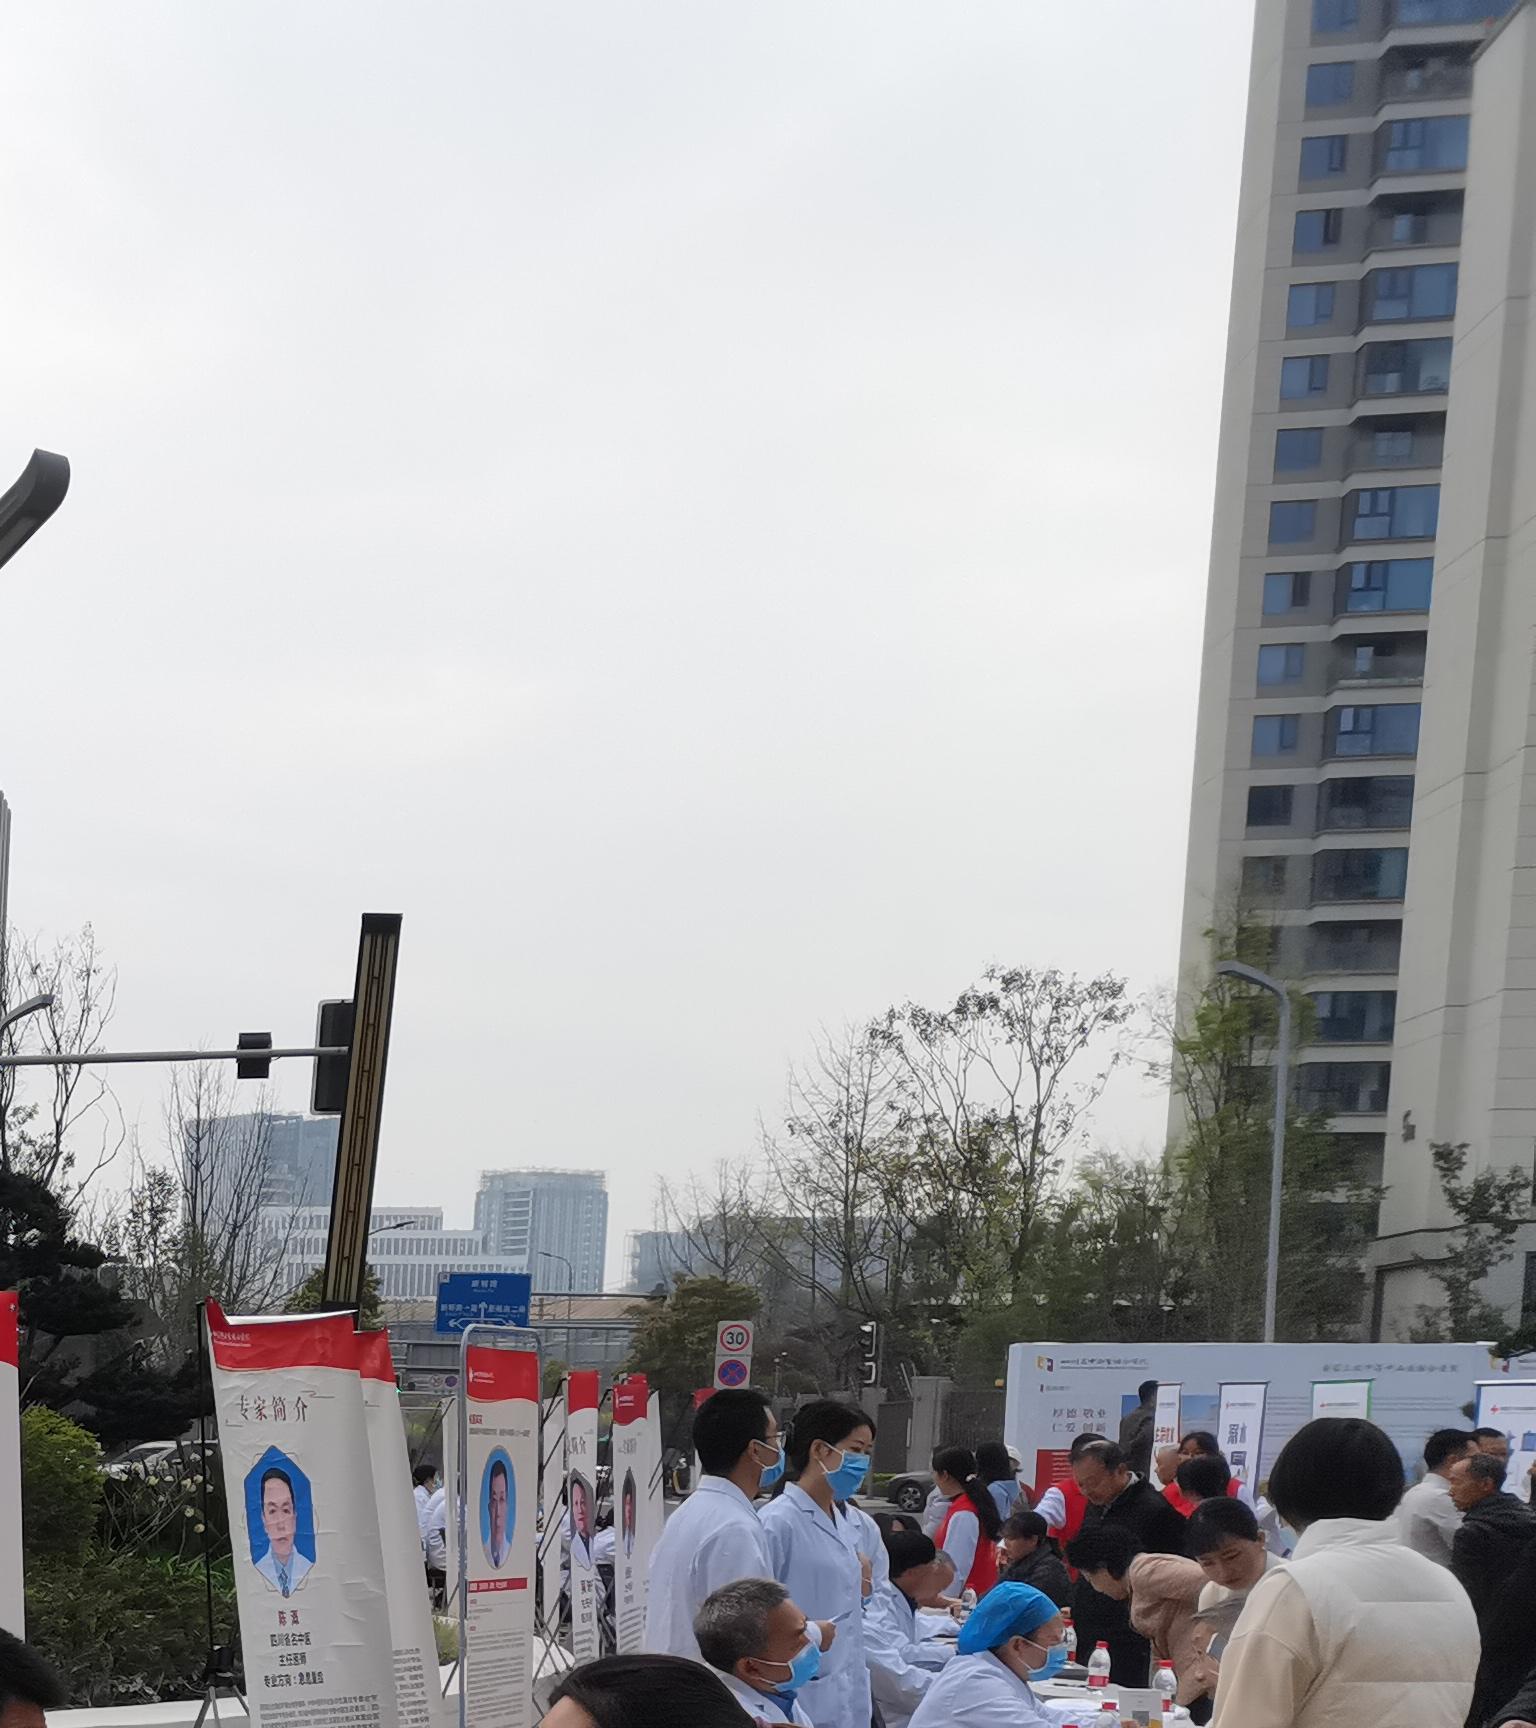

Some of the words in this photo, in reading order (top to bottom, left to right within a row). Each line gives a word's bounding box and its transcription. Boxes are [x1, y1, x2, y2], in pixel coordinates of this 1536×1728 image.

[726, 1331, 745, 1346] 30
[237, 1394, 308, 1422] 专家简介
